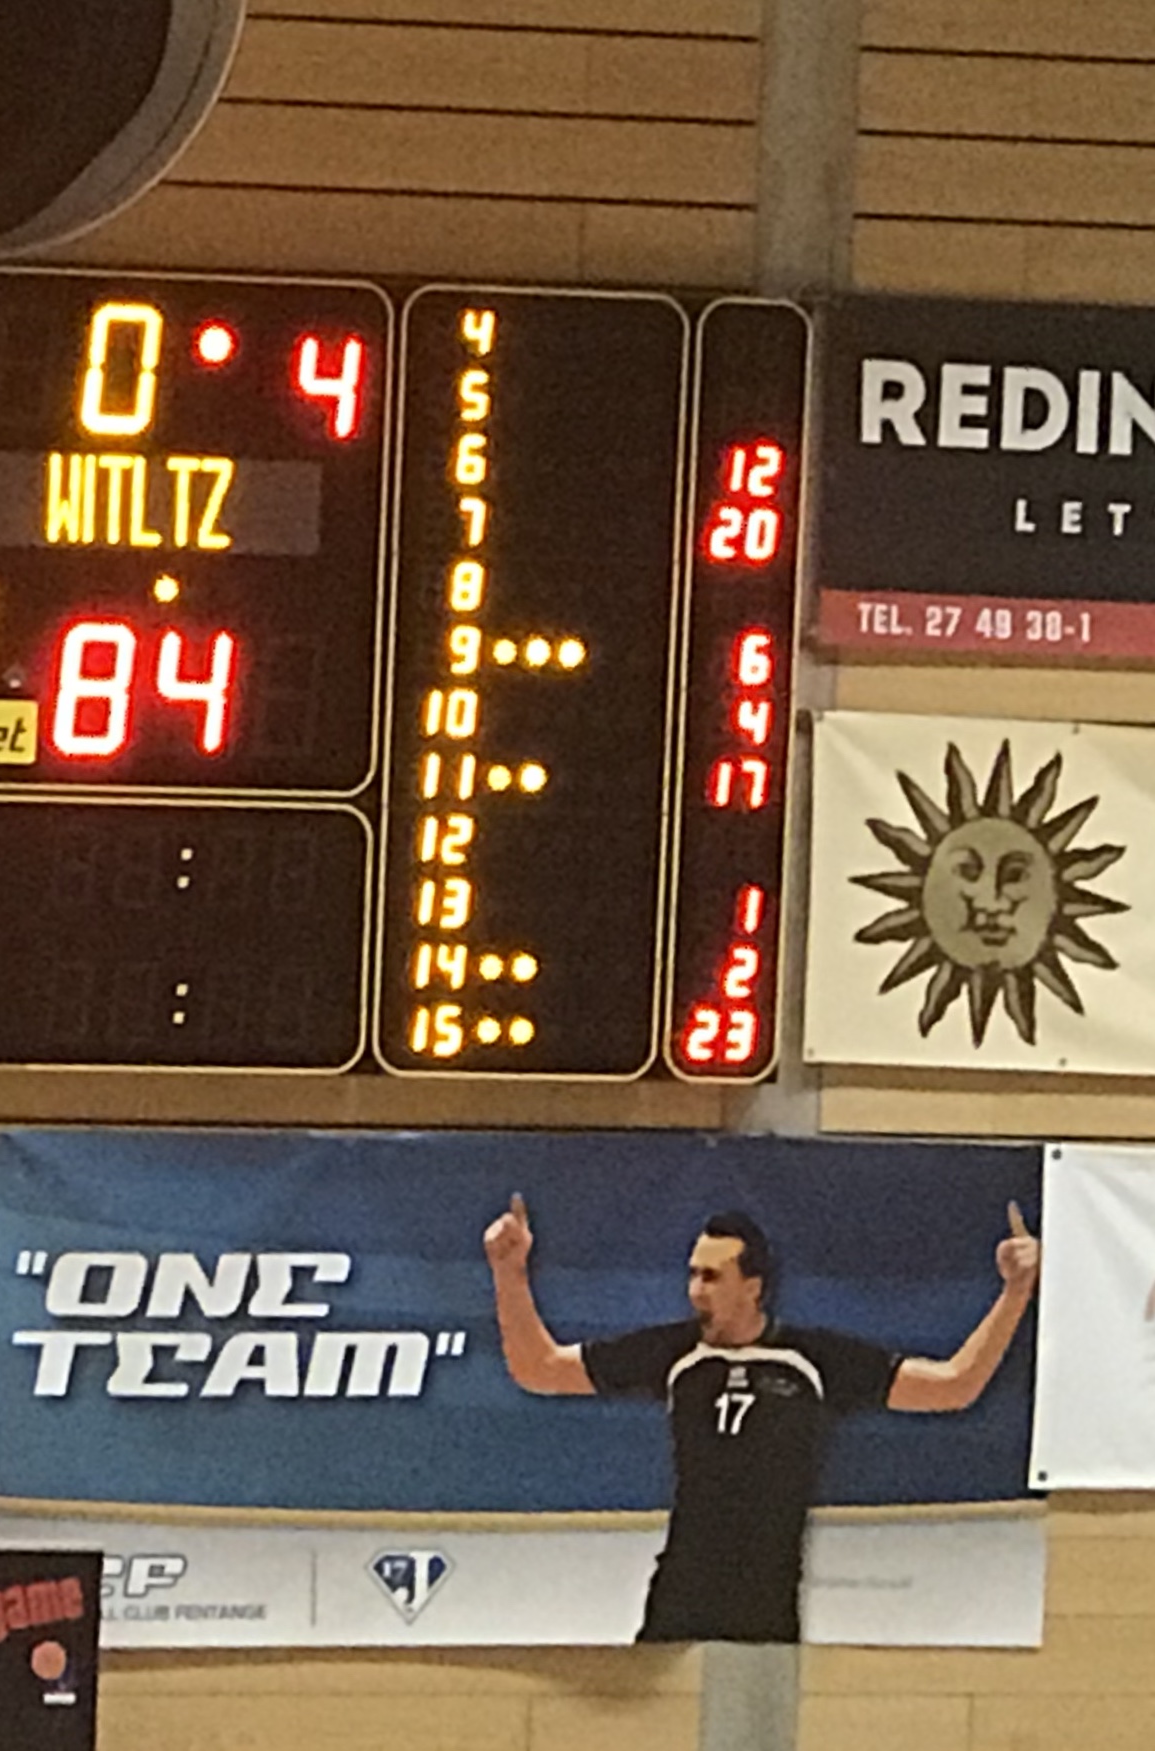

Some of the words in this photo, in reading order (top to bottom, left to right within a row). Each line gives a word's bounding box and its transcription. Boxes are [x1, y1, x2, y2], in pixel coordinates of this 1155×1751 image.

[462, 308, 495, 356] 4
[78, 301, 164, 437] 0
[295, 334, 366, 440] 4
[459, 368, 491, 423] 5
[860, 358, 1155, 455] REDIN
[454, 431, 487, 486] 6
[728, 443, 782, 499] 12
[45, 451, 235, 551] WITLTZ
[459, 495, 487, 548] 7
[707, 504, 780, 562] 20
[448, 558, 485, 613] 8
[857, 602, 913, 635] TEL.
[925, 605, 962, 637] 27
[447, 622, 482, 677] 9
[736, 629, 773, 687] 6
[49, 618, 239, 761] 84
[423, 686, 479, 741] 10
[735, 698, 771, 747] 4
[422, 751, 477, 802] 11
[713, 757, 769, 809] 17
[418, 813, 475, 867] 12
[415, 876, 472, 930] 13
[740, 885, 764, 935] 1
[413, 941, 469, 990] 14
[722, 945, 760, 1000] 2
[410, 1002, 465, 1059] 15
[684, 1006, 757, 1063] 23
[714, 1392, 757, 1435] 17
